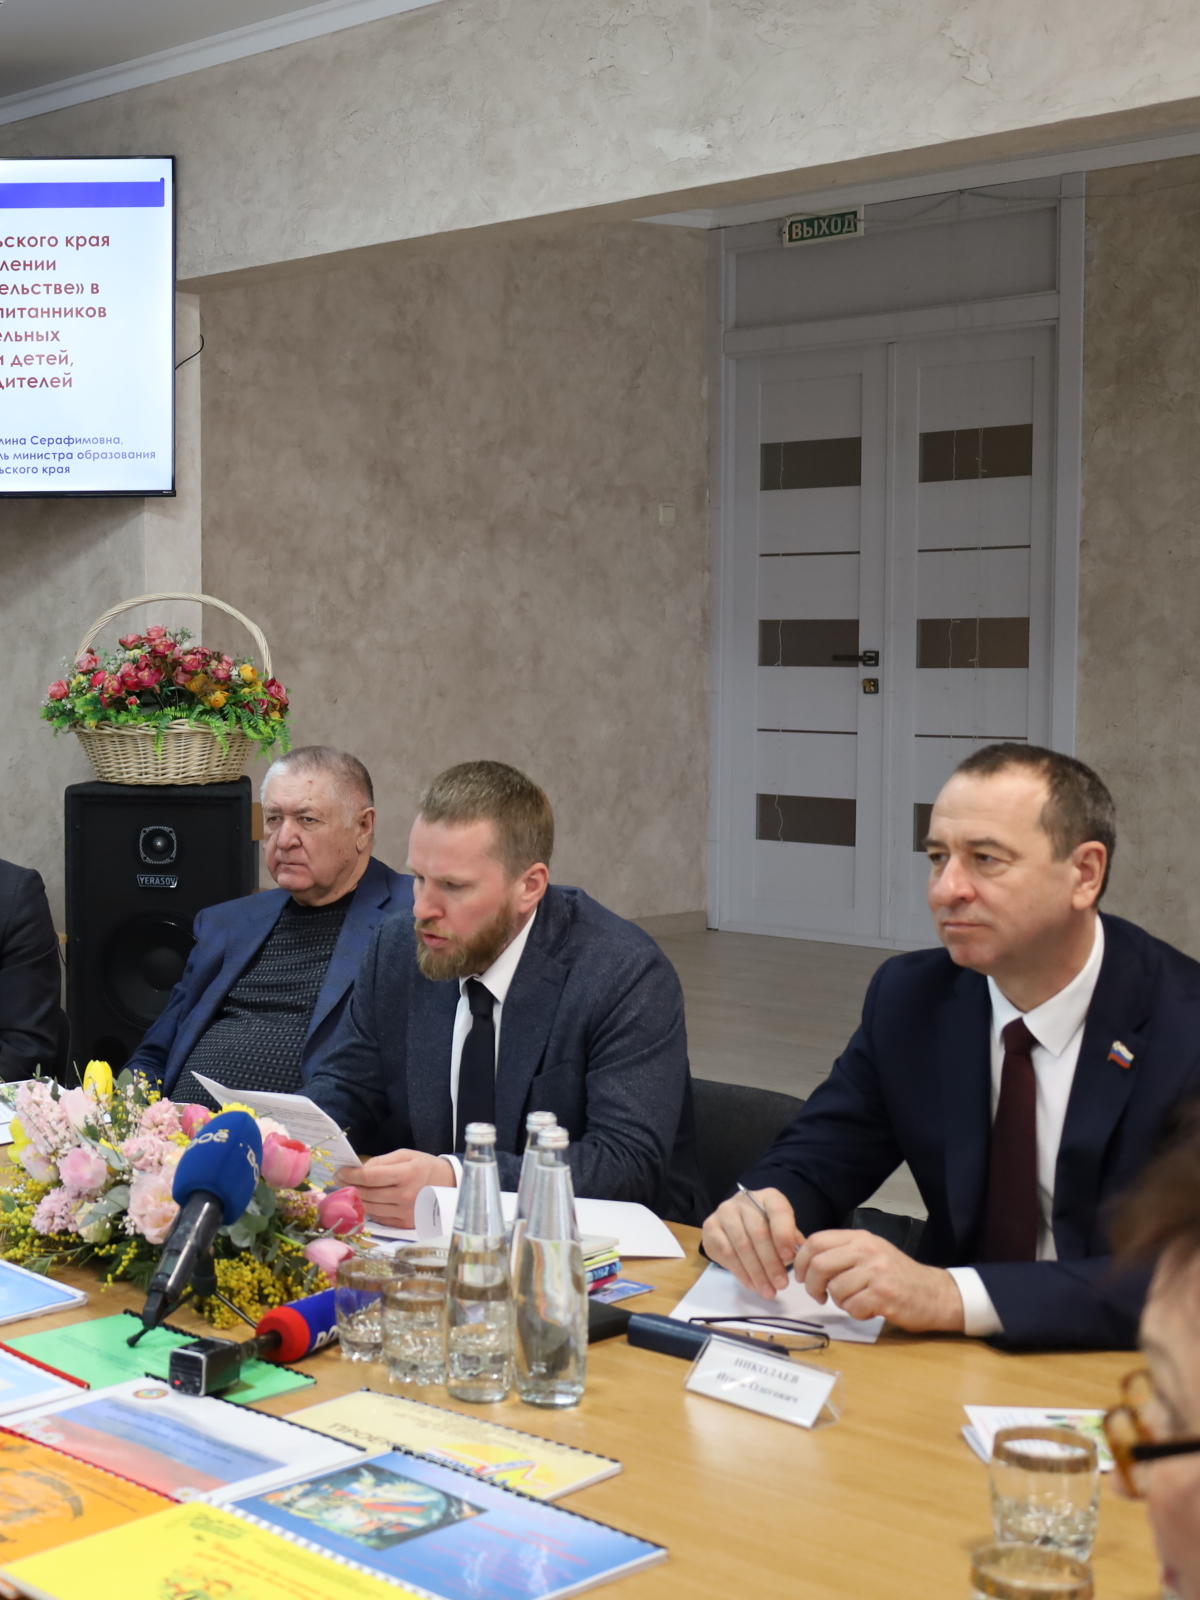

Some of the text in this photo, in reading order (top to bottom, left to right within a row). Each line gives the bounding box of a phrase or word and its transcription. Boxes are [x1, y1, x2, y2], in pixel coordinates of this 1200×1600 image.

[792, 214, 855, 239] ВЫХОД
[65, 235, 110, 250] края
[91, 283, 99, 294] в
[10, 350, 73, 367] детей,
[30, 435, 123, 447] Серафимовна,
[13, 452, 73, 462] министра
[77, 450, 155, 461] образования
[42, 466, 70, 476] края
[139, 876, 176, 886] YERASOV
[734, 1357, 800, 1384] НИКОЛАЕВ
